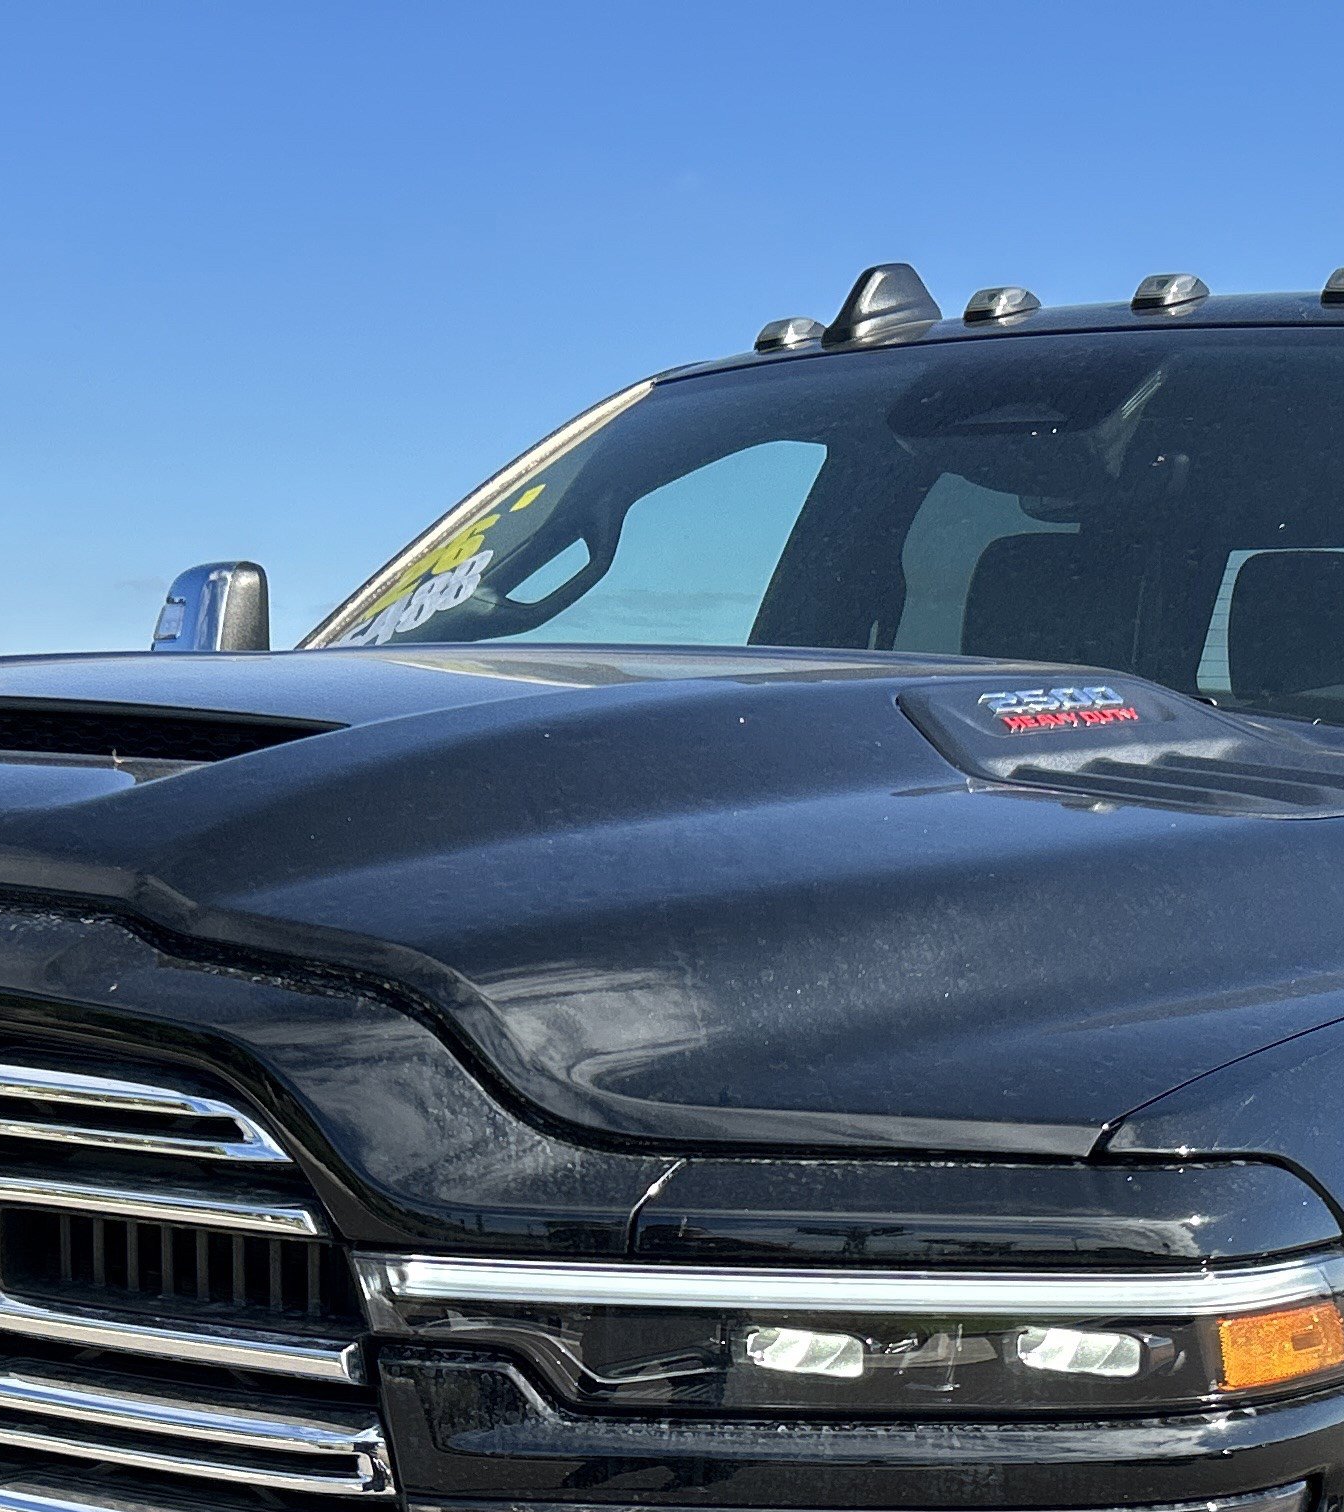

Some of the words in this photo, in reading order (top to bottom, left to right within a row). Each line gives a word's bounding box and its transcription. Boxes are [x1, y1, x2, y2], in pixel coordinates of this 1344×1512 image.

[978, 686, 1124, 715] 2500
[1003, 712, 1078, 733] HEAVY
[1080, 706, 1139, 728] DUTY
